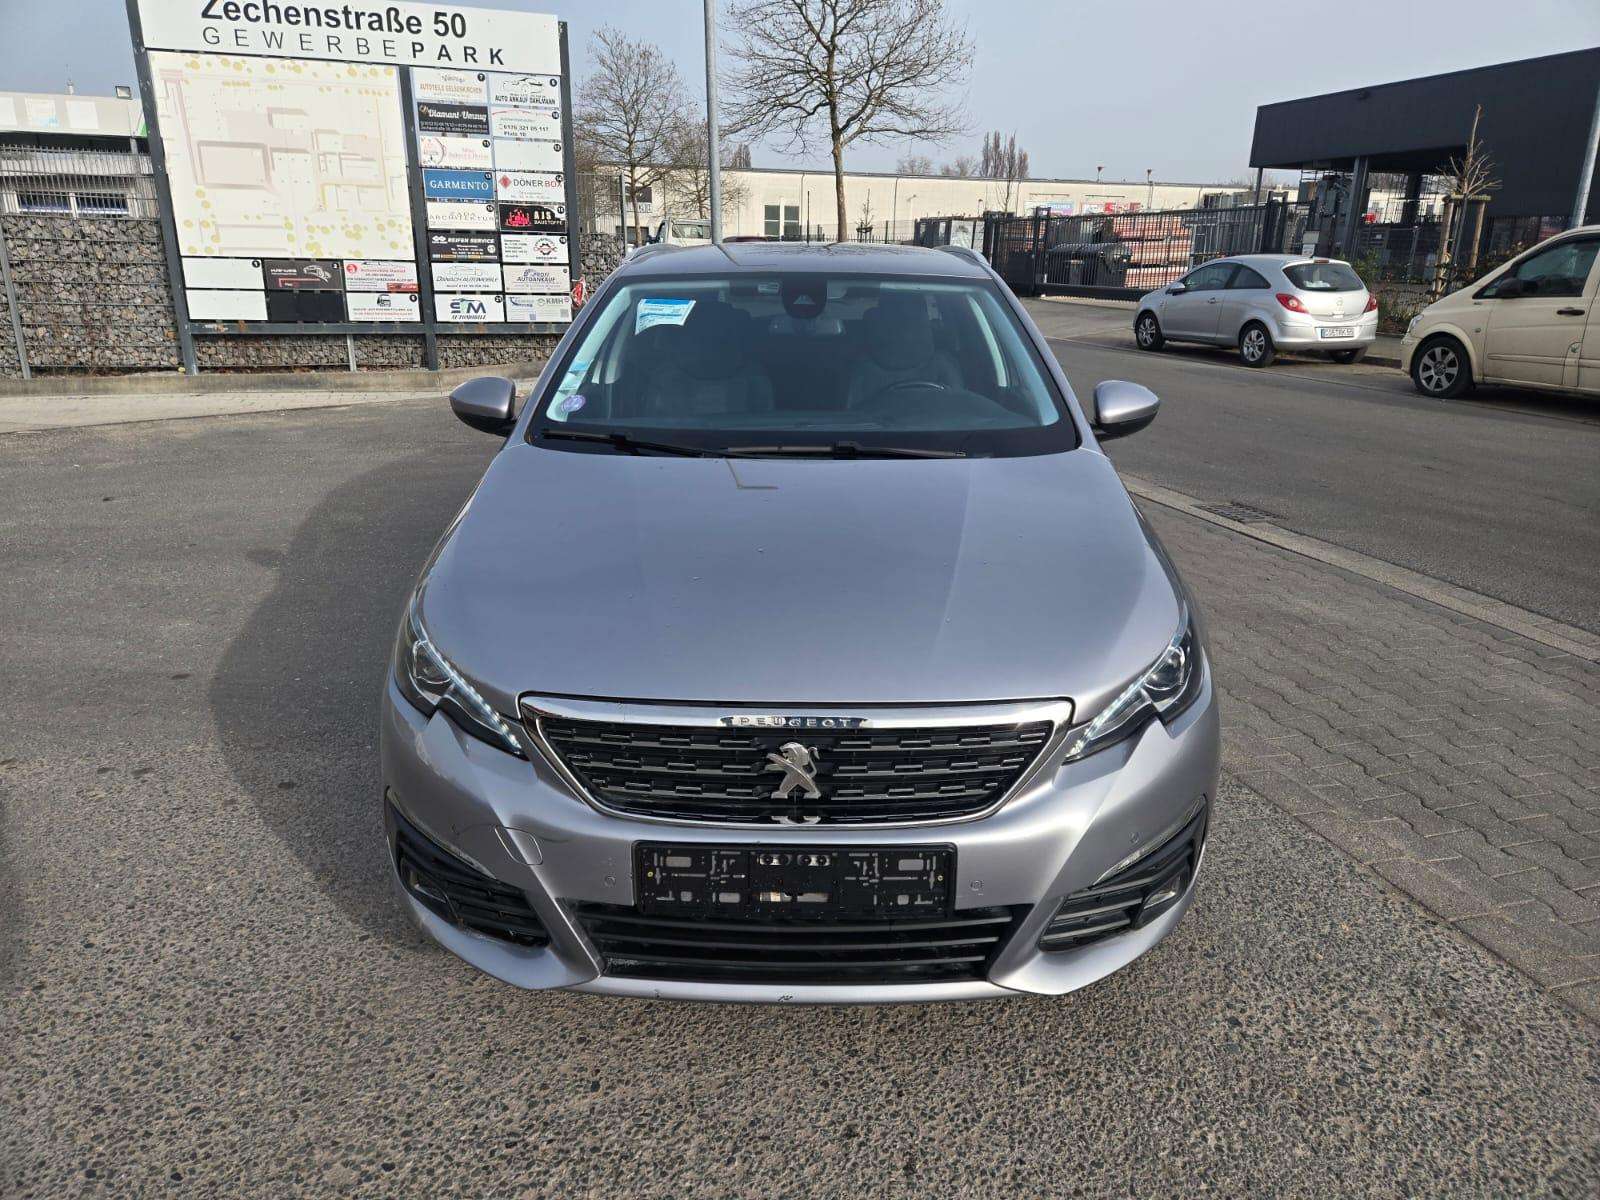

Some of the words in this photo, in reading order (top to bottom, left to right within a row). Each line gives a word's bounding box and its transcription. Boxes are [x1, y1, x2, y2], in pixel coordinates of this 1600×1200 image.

[201, 0, 423, 35] Zechenstraße
[433, 12, 467, 39] 50
[202, 26, 505, 65] GEWERBEPARK
[495, 94, 508, 102] AUTO
[430, 179, 489, 191] GARMENTO
[739, 716, 852, 728] PEUGEOT
